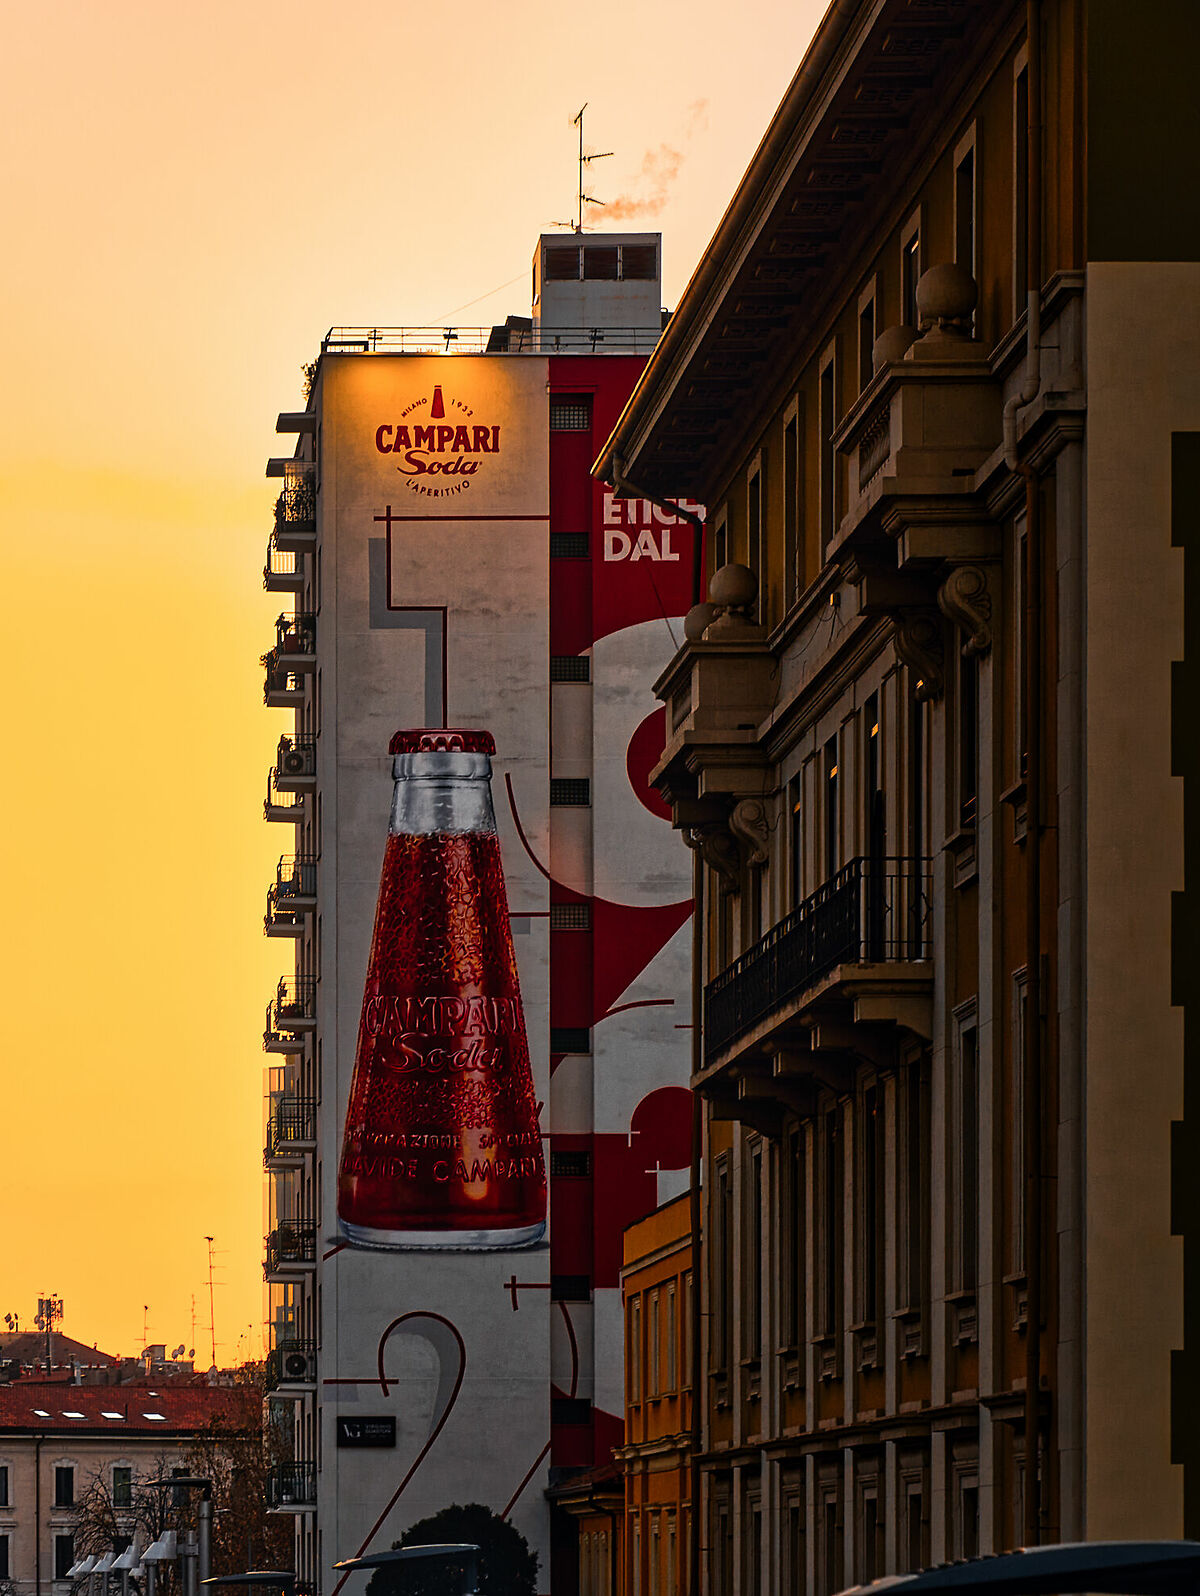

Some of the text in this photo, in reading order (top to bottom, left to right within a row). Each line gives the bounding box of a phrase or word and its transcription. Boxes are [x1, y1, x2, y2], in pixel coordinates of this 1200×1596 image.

[401, 397, 474, 418] MILANO 1932
[375, 424, 501, 454] CAMPARI
[396, 449, 482, 476] Soda
[405, 478, 470, 498] L'APERITIVO
[603, 529, 680, 562] DAL
[365, 995, 524, 1038] CAMPARI
[432, 1156, 537, 1184] CAMPARI
